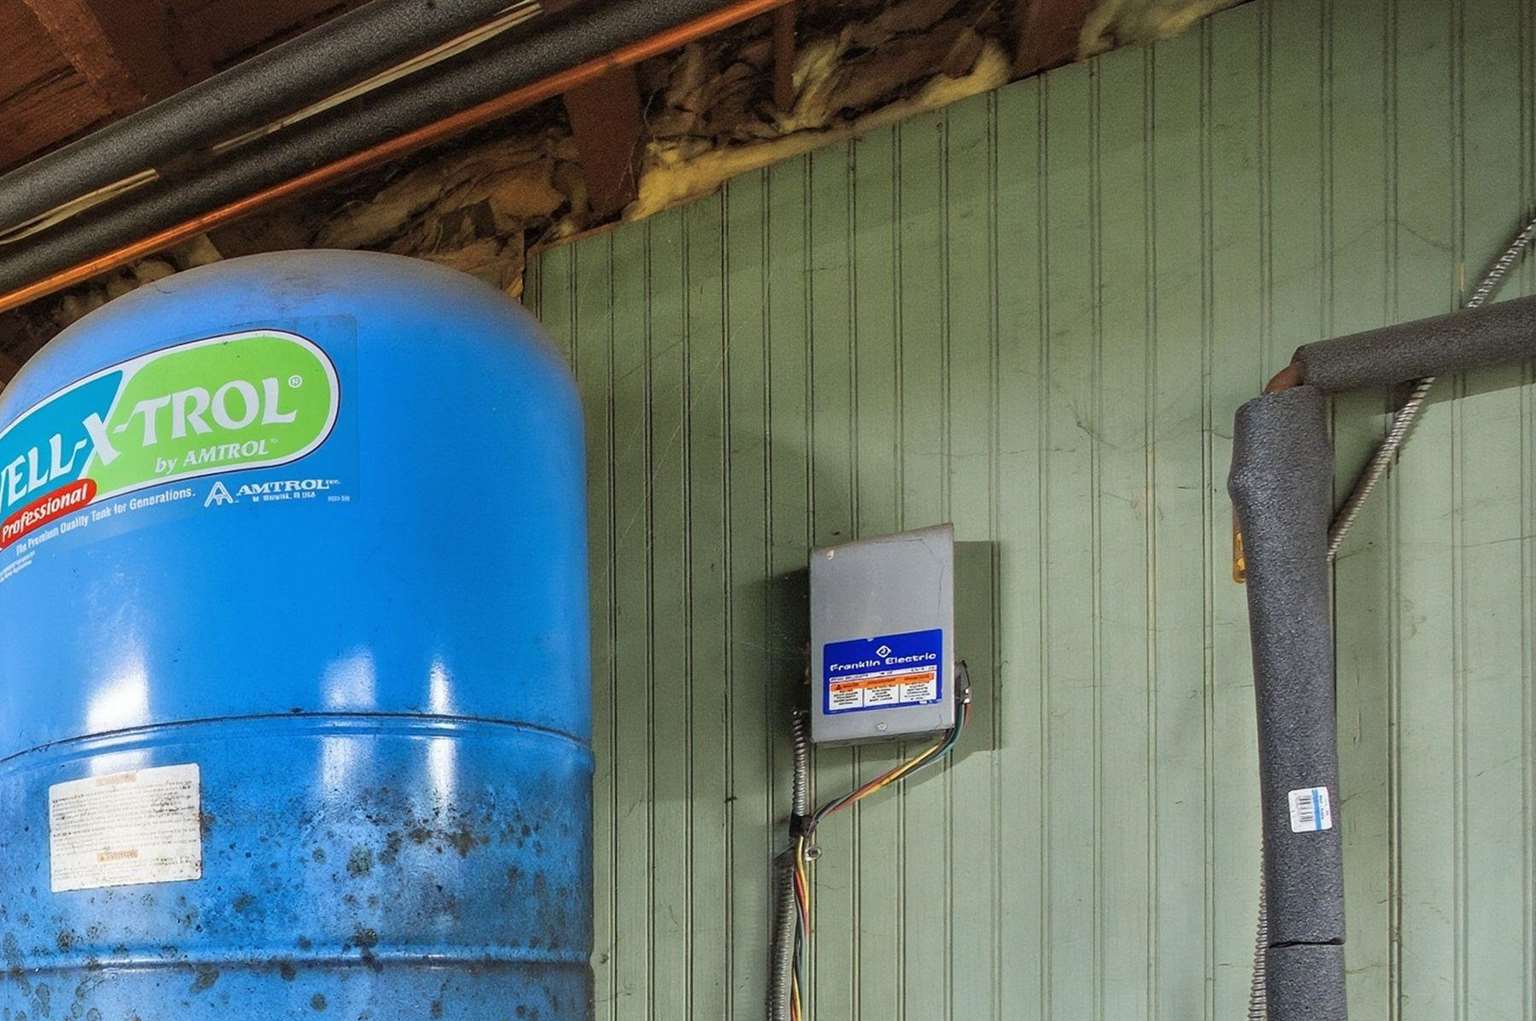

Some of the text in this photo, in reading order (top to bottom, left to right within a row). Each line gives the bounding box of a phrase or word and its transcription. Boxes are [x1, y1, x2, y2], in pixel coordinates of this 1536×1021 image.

[154, 439, 271, 474] by AMTROL
[236, 479, 330, 497] AMTROL
[2, 482, 88, 542] Professional
[60, 515, 89, 534] Quality
[114, 502, 127, 515] for
[129, 486, 197, 511] Generations.
[830, 651, 937, 672] Franklin Electric
